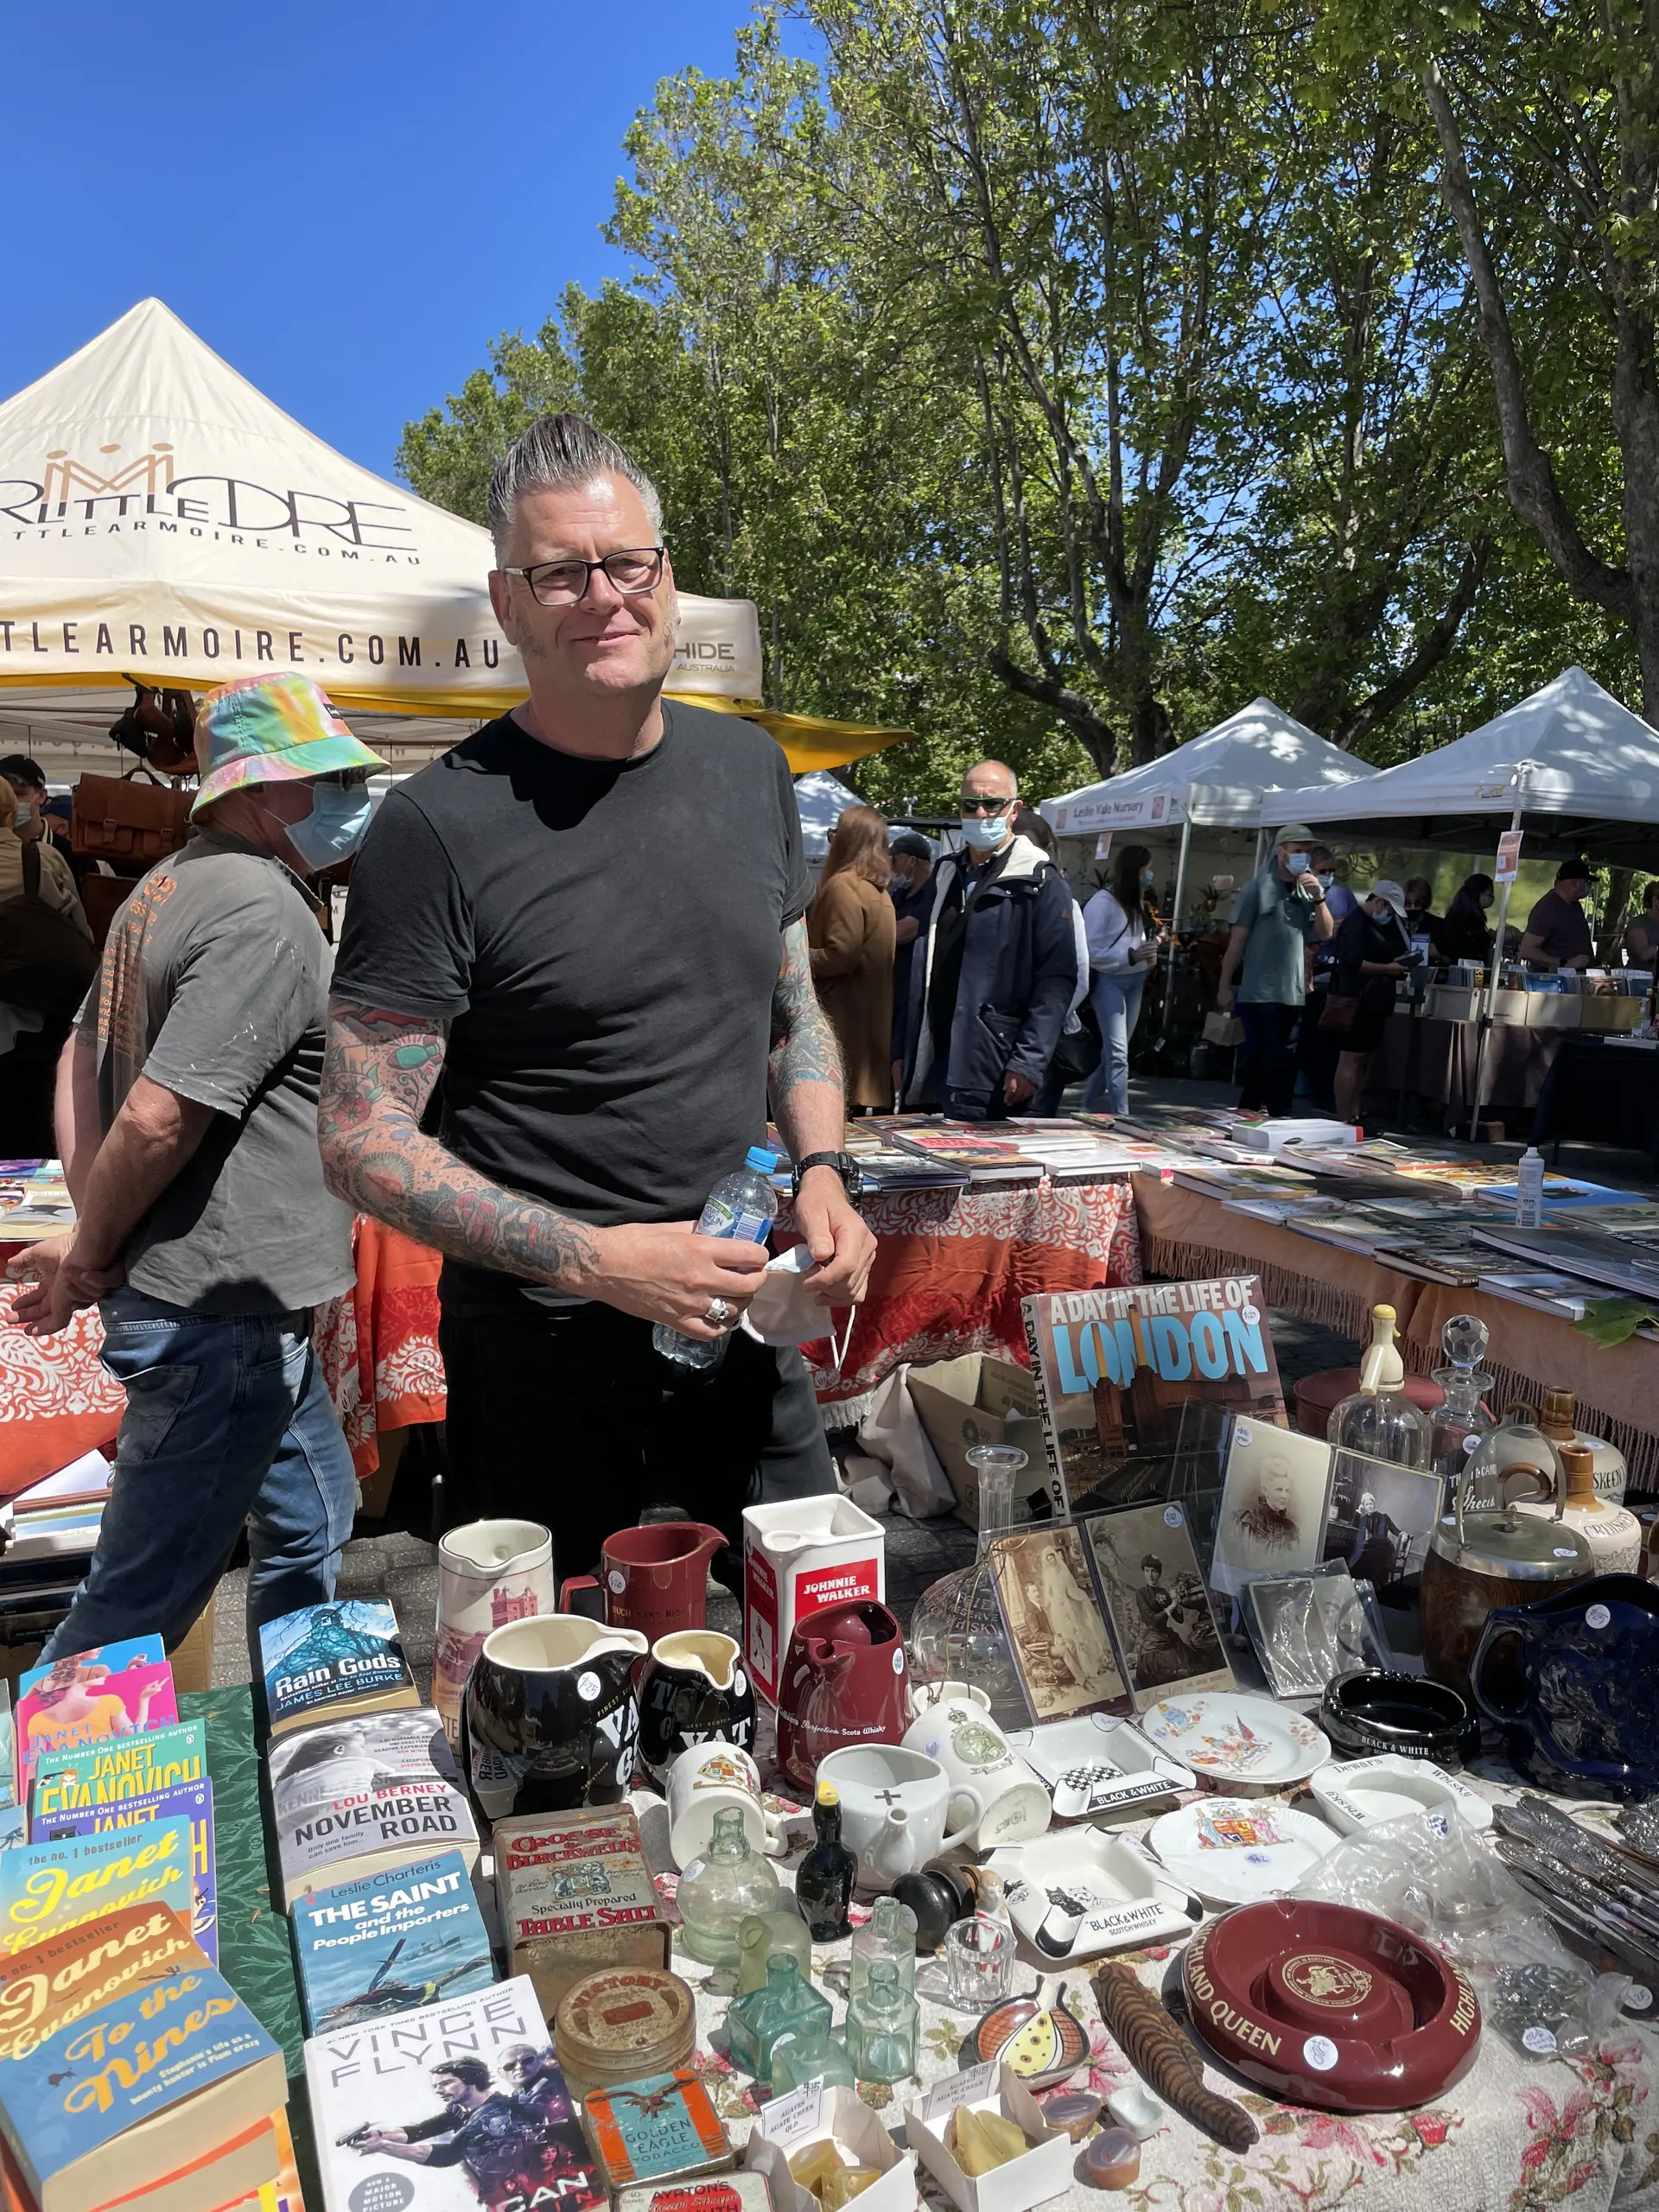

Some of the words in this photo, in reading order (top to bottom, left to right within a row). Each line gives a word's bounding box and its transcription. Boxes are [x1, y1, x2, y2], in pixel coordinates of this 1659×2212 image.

[0, 620, 499, 670] TLEARMOIRE.COM.AU
[677, 664, 735, 672] AUSTRALIA
[1113, 800, 1144, 814] Nursery
[1051, 1296, 1065, 1324] A
[1066, 1292, 1109, 1322] DAY
[1112, 1287, 1134, 1316] IN
[1135, 1283, 1180, 1318] THE
[1180, 1281, 1224, 1313] LIFE
[1224, 1279, 1253, 1308] OF
[1026, 1320, 1039, 1356] DAY
[1052, 1310, 1268, 1394] LONDON
[1029, 1356, 1042, 1382] IN
[1036, 1384, 1052, 1427] THE
[1043, 1431, 1059, 1477] LIFE
[1052, 1480, 1065, 1510] OF
[747, 1555, 768, 1582] JOHNNIE
[752, 1569, 774, 1599] WALKER
[804, 1576, 856, 1595] JOHNNIE
[817, 1585, 870, 1603] WALKER
[275, 1667, 331, 1699] Rain
[338, 1653, 401, 1675] Gods
[276, 1690, 323, 1712] JAMES
[327, 1681, 352, 1694] LEE
[356, 1674, 404, 1686] BURKE
[597, 1695, 620, 1718] FINEST
[23, 1714, 175, 1765] EVANOVICH
[34, 1722, 92, 1749] JANET
[801, 1719, 840, 1735] Perfection
[862, 1726, 886, 1735] Whisky
[45, 1756, 60, 1765] THE
[61, 1748, 95, 1762] NUMBER
[98, 1744, 114, 1755] ONE
[117, 1732, 166, 1751] BESTSELLING
[168, 1724, 198, 1738] AUTHOR
[1362, 1736, 1389, 1750] BLACK
[1390, 1744, 1396, 1752] &
[1399, 1745, 1429, 1756] WHITE
[89, 1743, 156, 1780] JANET
[41, 1756, 200, 1815] EVANOVICH
[334, 1793, 369, 1811] LOU
[376, 1784, 448, 1800] BERNEY
[41, 1816, 57, 1826] THE
[60, 1809, 95, 1823] NUMBER
[98, 1806, 115, 1816] ONE
[118, 1792, 170, 1812] BESTSELLING
[173, 1783, 205, 1797] AUTHOR
[93, 1804, 160, 1834] JANET
[295, 1796, 453, 1847] NOVEMBER
[380, 1815, 457, 1840] ROAD
[29, 1855, 48, 1866] the
[51, 1852, 68, 1863] no.
[84, 1833, 143, 1858] bestseller
[308, 1843, 324, 1853] Only
[326, 1838, 340, 1847] one
[341, 1831, 364, 1842] family
[308, 1850, 323, 1859] can
[324, 1844, 342, 1854] save
[10, 1829, 180, 1923] Janet
[331, 1880, 371, 1900] Leslie
[373, 1860, 442, 1887] Charteris
[3, 1867, 183, 1955] Evanovich
[308, 1900, 368, 1928] THE
[370, 1872, 461, 1916] SAINT
[531, 1900, 583, 1915] Specially
[585, 1892, 636, 1909] Prepared
[313, 1928, 377, 1951] People
[380, 1903, 470, 1937] Importers
[355, 1911, 391, 1931] and
[395, 1904, 425, 1921] the
[517, 1912, 596, 1937] TABLE
[597, 1904, 657, 1928] SALT
[1109, 1922, 1132, 1936] SCOTCH
[1133, 1917, 1158, 1933] WHISKY
[48, 1921, 120, 1959] bestseller
[0, 1912, 171, 2034] Janet
[0, 1937, 191, 2060] Evanovich
[65, 2022, 136, 2063] To
[139, 1974, 202, 2021] the
[328, 1996, 516, 2061] VINCE
[338, 2032, 359, 2043] NEW
[362, 2024, 387, 2034] YORK
[390, 2018, 416, 2027] TIMES
[418, 2000, 477, 2020] BESTSELLING
[480, 1987, 514, 2002] AUTHOR
[1211, 2000, 1282, 2056] QUEEN
[64, 1996, 238, 2113] Nines
[331, 2017, 527, 2088] FLYNN
[803, 2081, 820, 2097] $15
[936, 2089, 960, 2103] AGATE
[961, 2081, 984, 2095] CREEK
[770, 2116, 791, 2134] AGATE
[791, 2103, 815, 2123] CREEK
[781, 2100, 805, 2118] AGATES
[625, 2118, 691, 2144] GOLDEN
[785, 2121, 798, 2133] QLD
[633, 2142, 700, 2163] TOBACCO
[638, 2132, 690, 2154] EAGLE
[362, 2196, 404, 2212] PICTURE
[363, 2189, 402, 2205] MOTION
[365, 2183, 397, 2196] MAJOR
[652, 2179, 730, 2202] AYRTON'S
